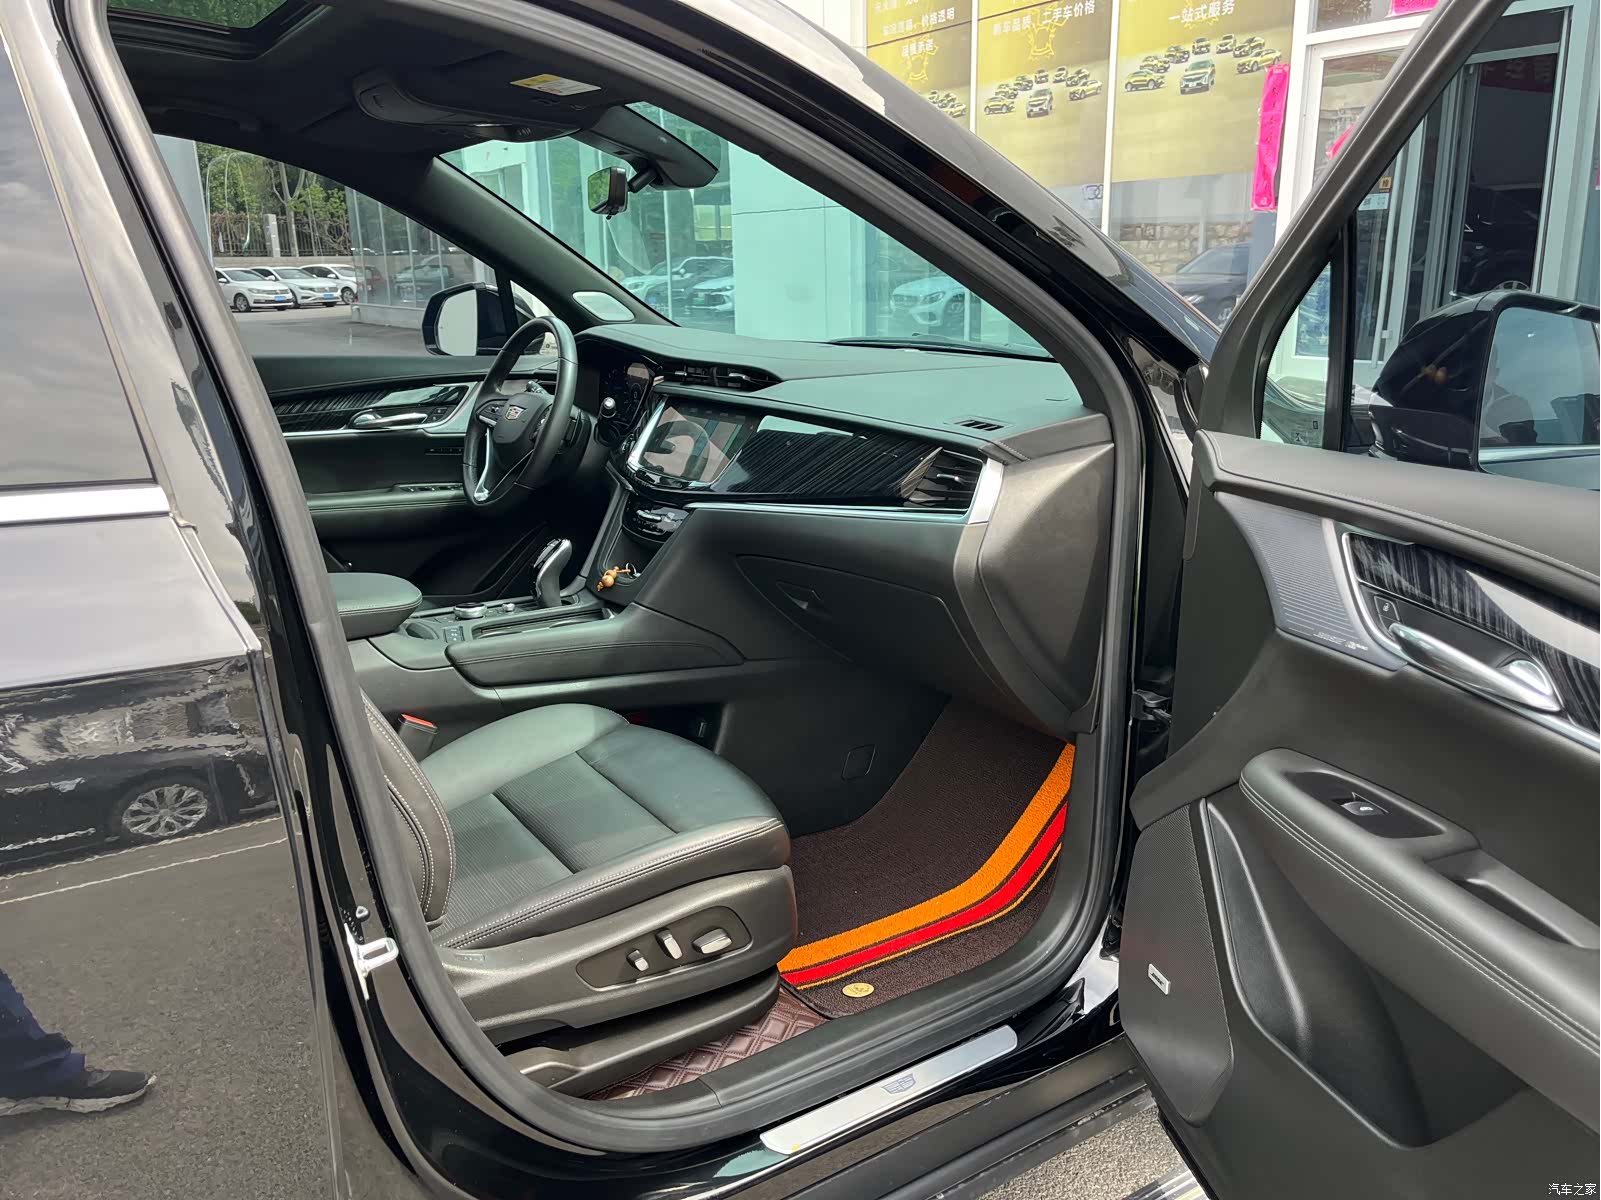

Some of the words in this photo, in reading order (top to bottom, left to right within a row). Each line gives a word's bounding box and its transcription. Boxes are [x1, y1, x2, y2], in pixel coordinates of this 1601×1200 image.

[1041, 0, 1096, 25] 二手车价格
[1168, 0, 1235, 23] 一站式服务
